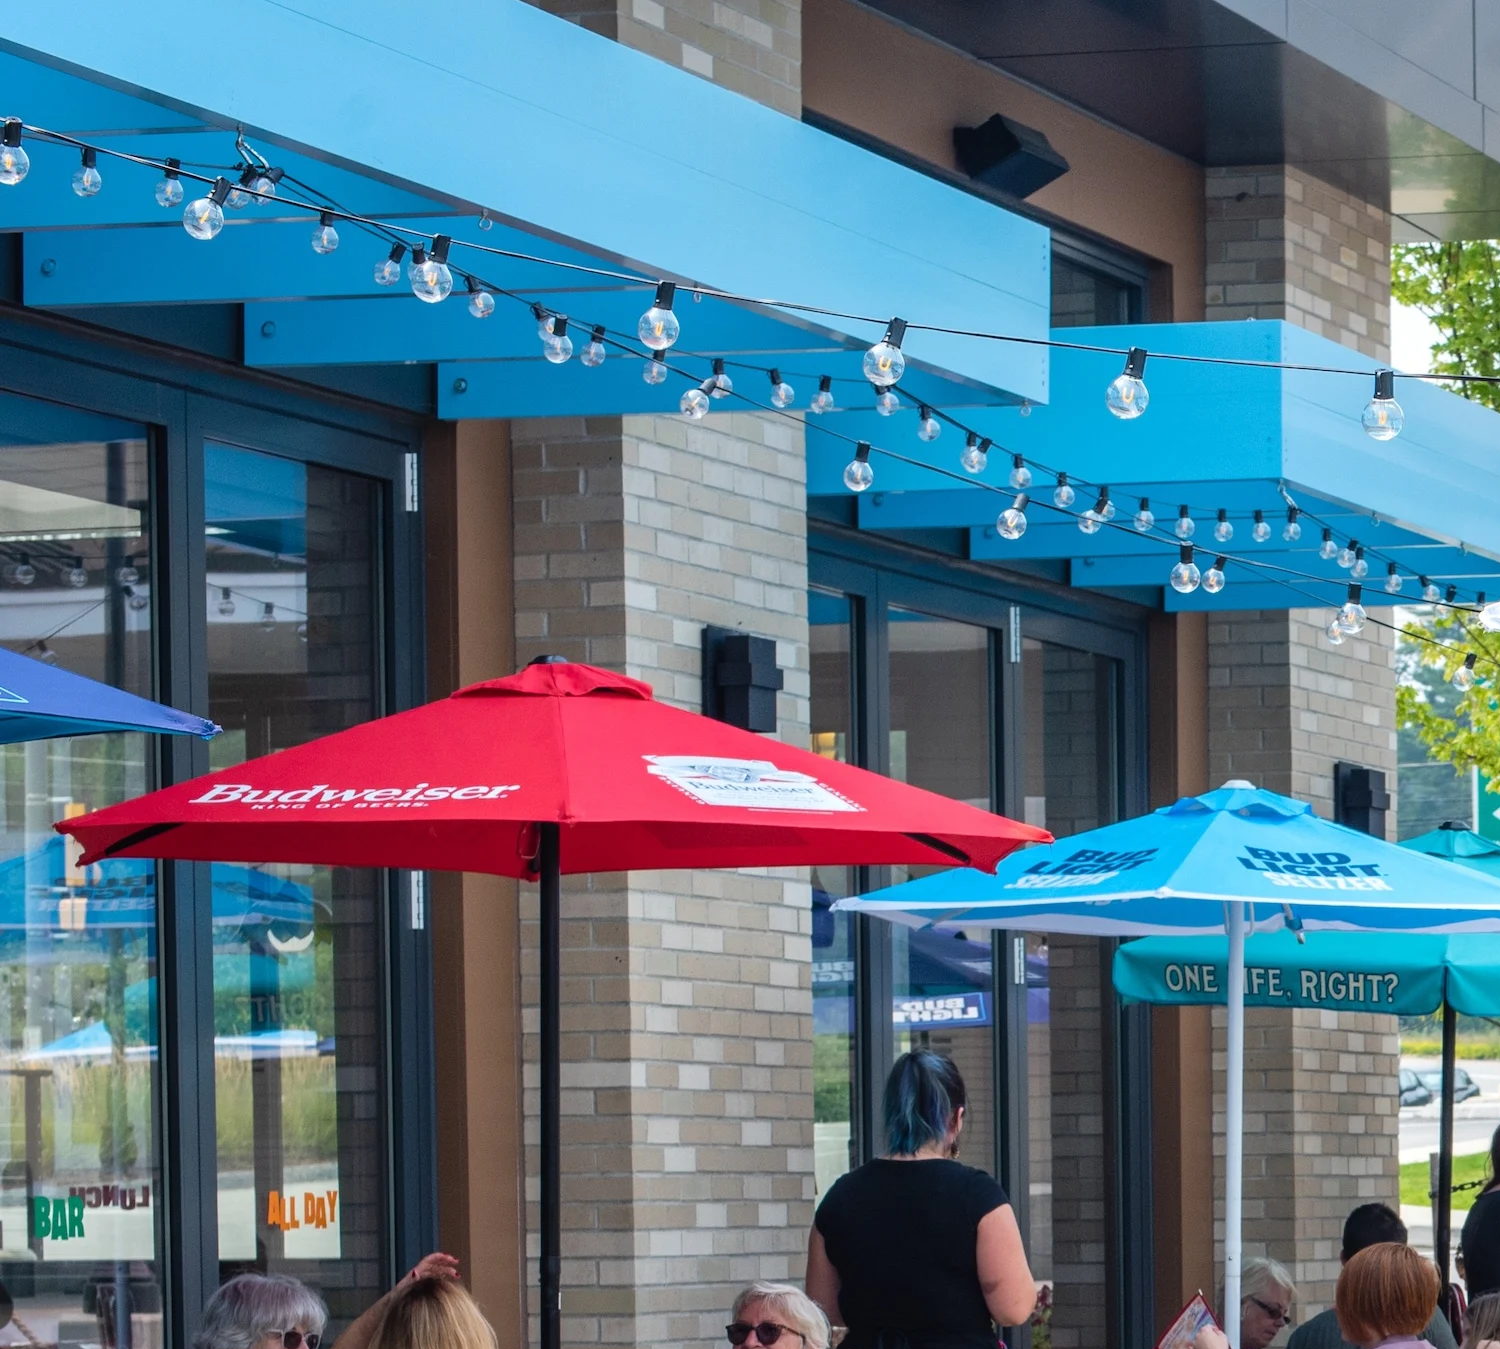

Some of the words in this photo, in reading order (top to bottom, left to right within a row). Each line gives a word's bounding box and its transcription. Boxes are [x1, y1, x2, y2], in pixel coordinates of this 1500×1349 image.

[188, 782, 520, 804] Budweiser
[688, 780, 815, 795] Budweiser
[1064, 848, 1159, 863] BUD
[1244, 846, 1351, 865] BUD
[1024, 859, 1156, 875] LIGHT
[1236, 857, 1381, 877] LIGHT
[1262, 872, 1393, 891] SELTZER
[1165, 964, 1218, 993] ONE
[1243, 967, 1292, 999] IFE,
[1300, 970, 1399, 1003] RIGHT?
[34, 1196, 85, 1240] BAR
[267, 1190, 299, 1231] ALL
[304, 1190, 338, 1229] DAY
